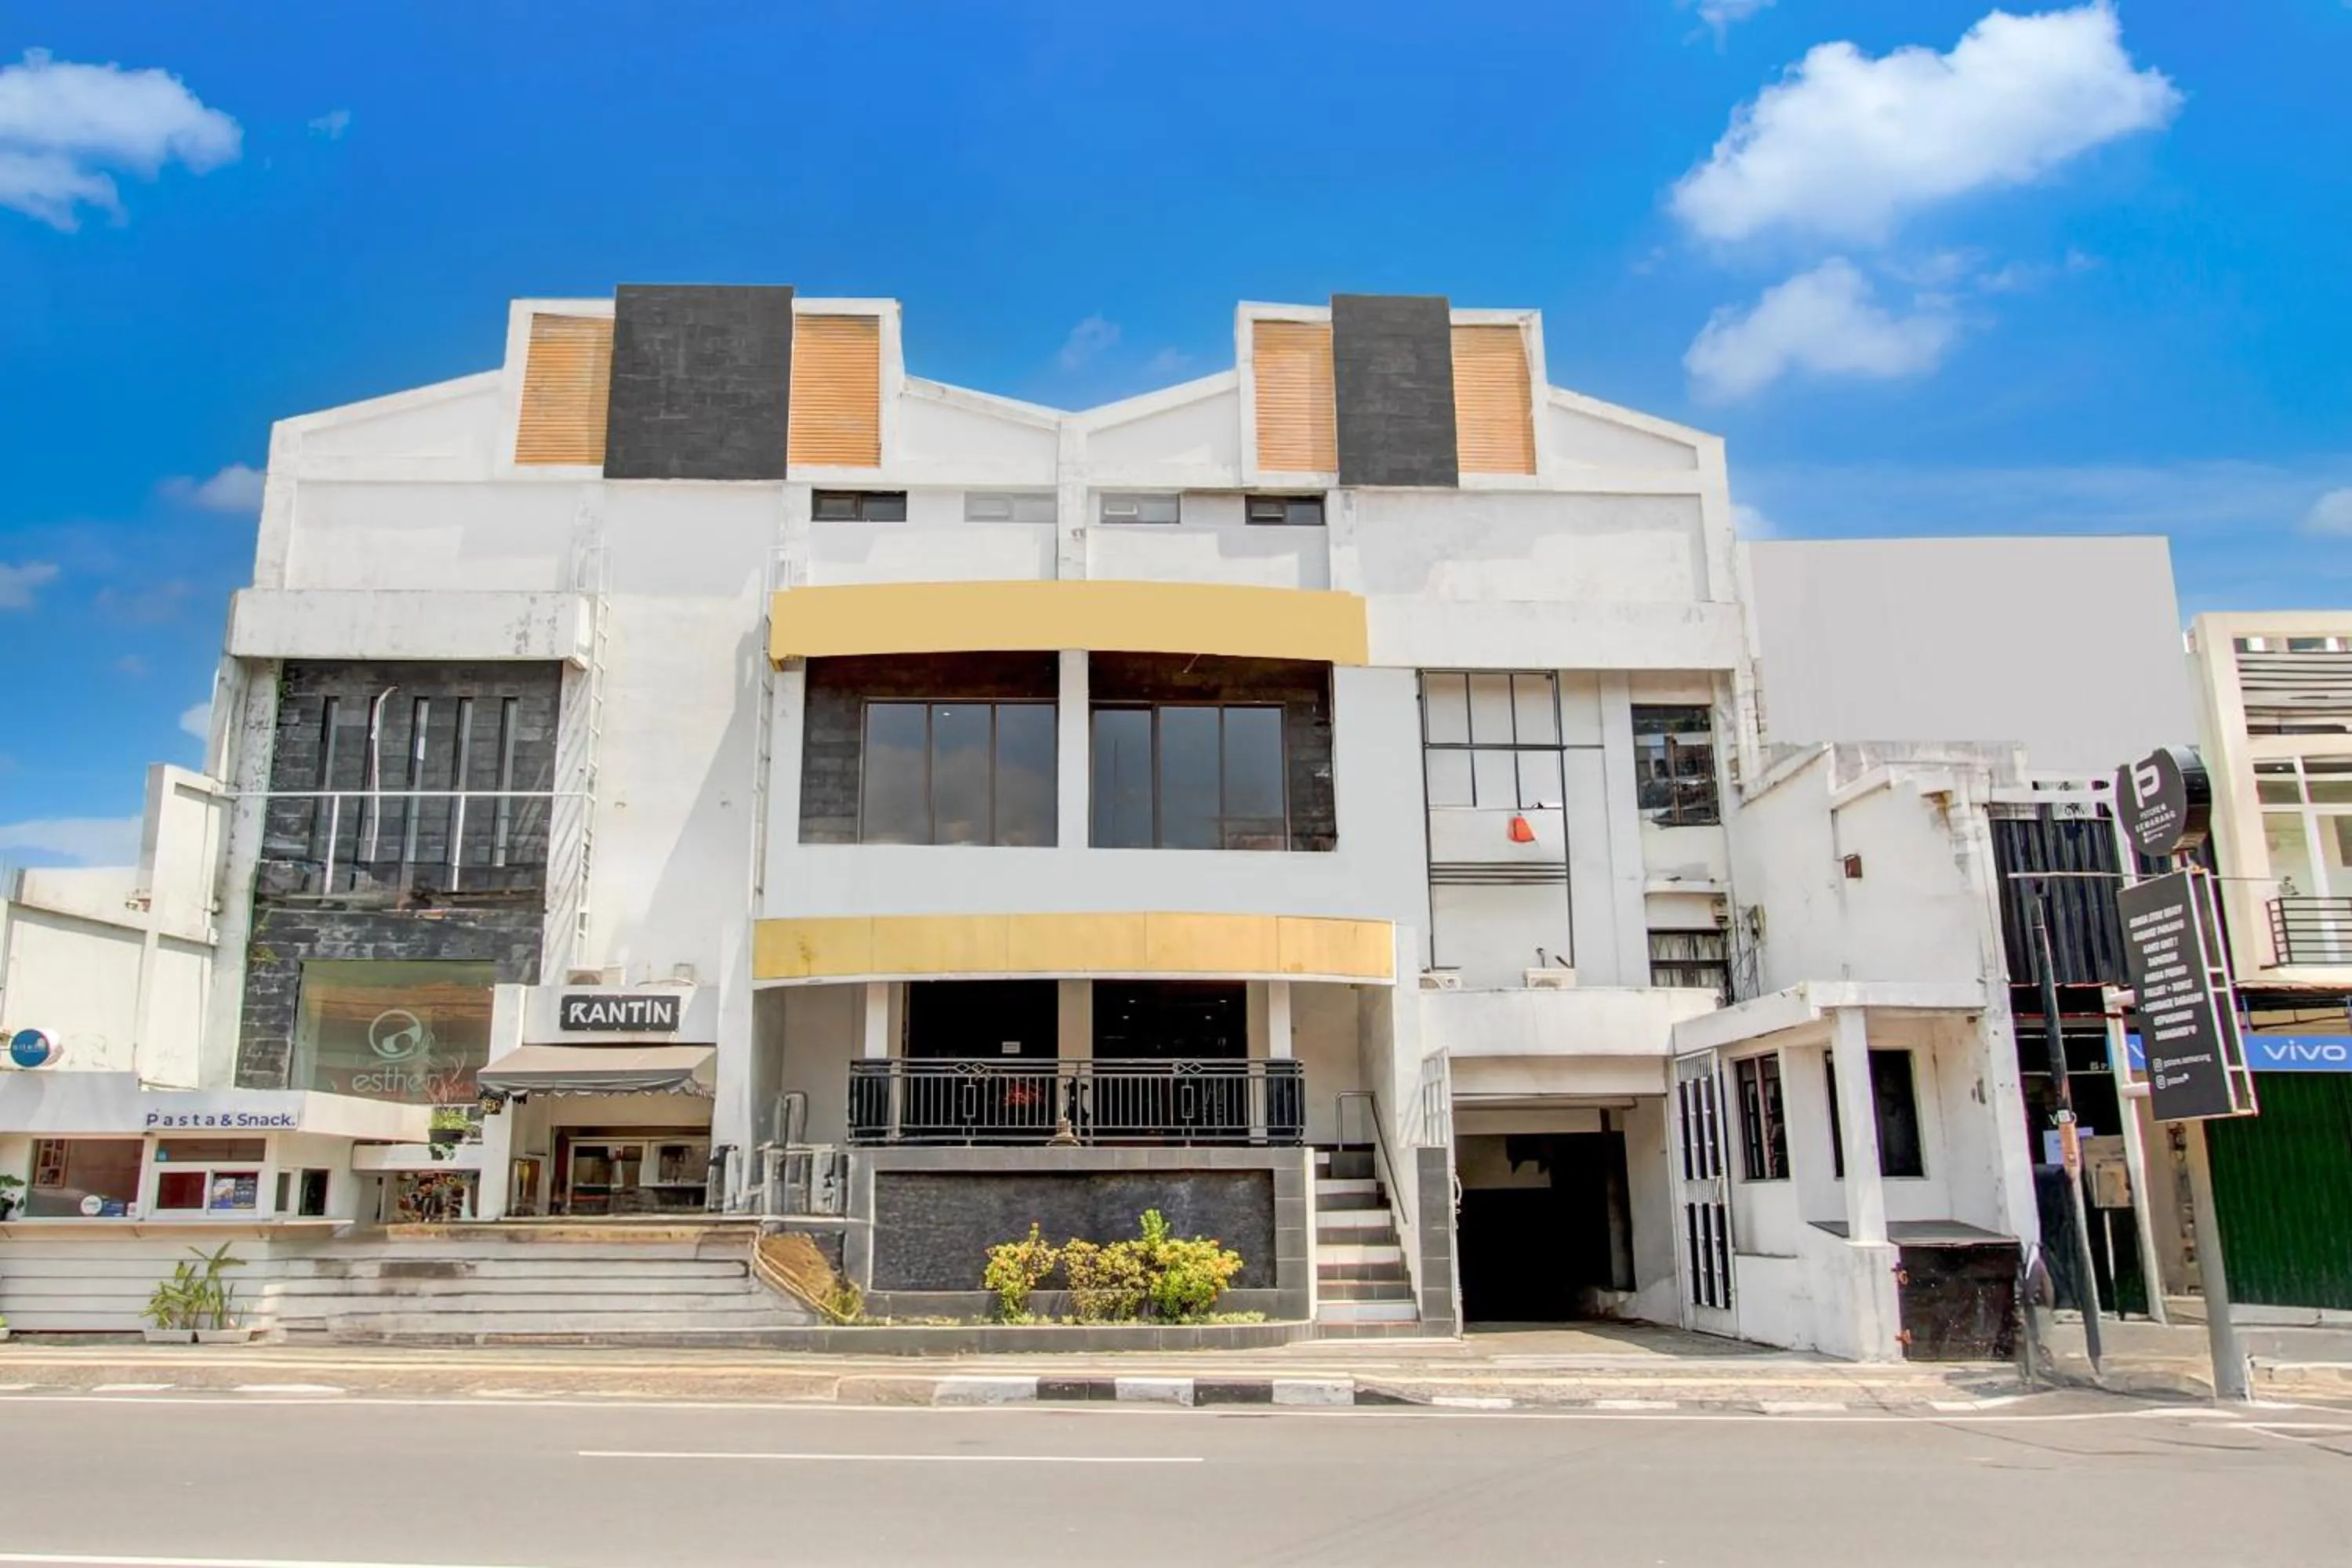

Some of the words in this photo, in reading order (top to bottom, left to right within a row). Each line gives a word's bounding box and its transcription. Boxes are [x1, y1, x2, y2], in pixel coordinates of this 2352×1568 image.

[569, 1000, 672, 1023] KANTIN
[2263, 1039, 2347, 1061] vivo
[147, 1113, 216, 1127] Pasta
[220, 1113, 232, 1127] &
[237, 1112, 296, 1127] Snack.
